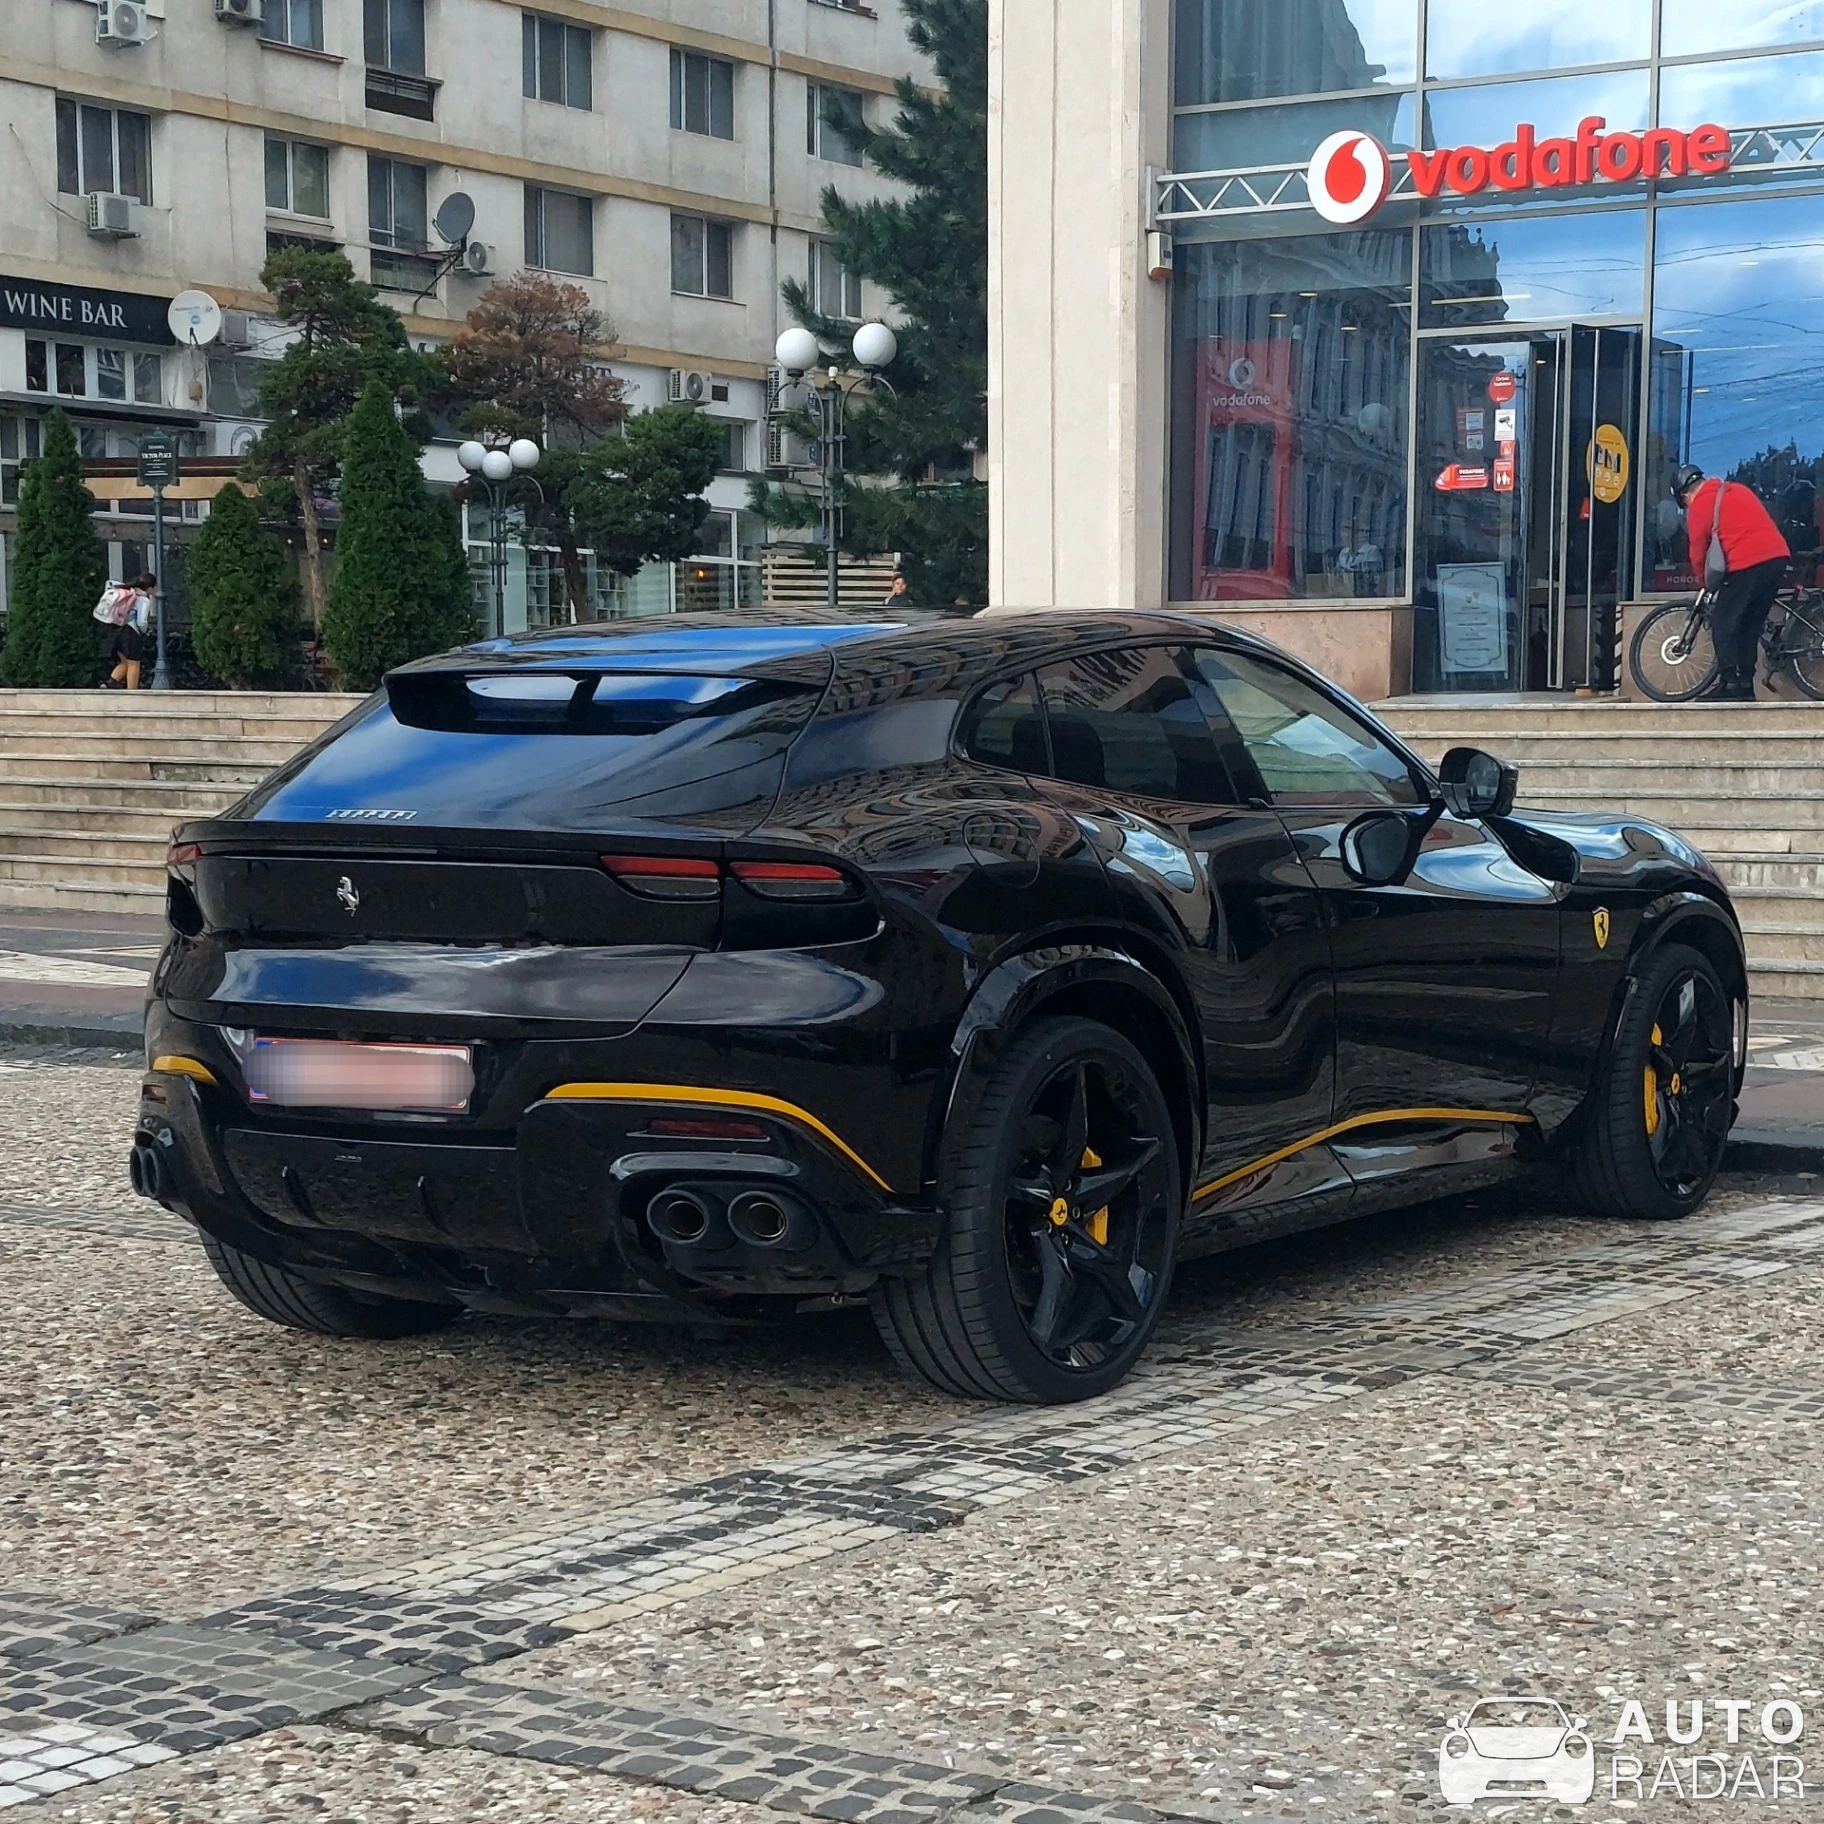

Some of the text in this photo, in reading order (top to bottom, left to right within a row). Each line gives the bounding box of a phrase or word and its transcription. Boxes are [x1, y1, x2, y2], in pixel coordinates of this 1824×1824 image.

[1407, 116, 1732, 197] vodafone
[4, 290, 129, 328] WINE BAR
[1213, 393, 1271, 406] vodafone
